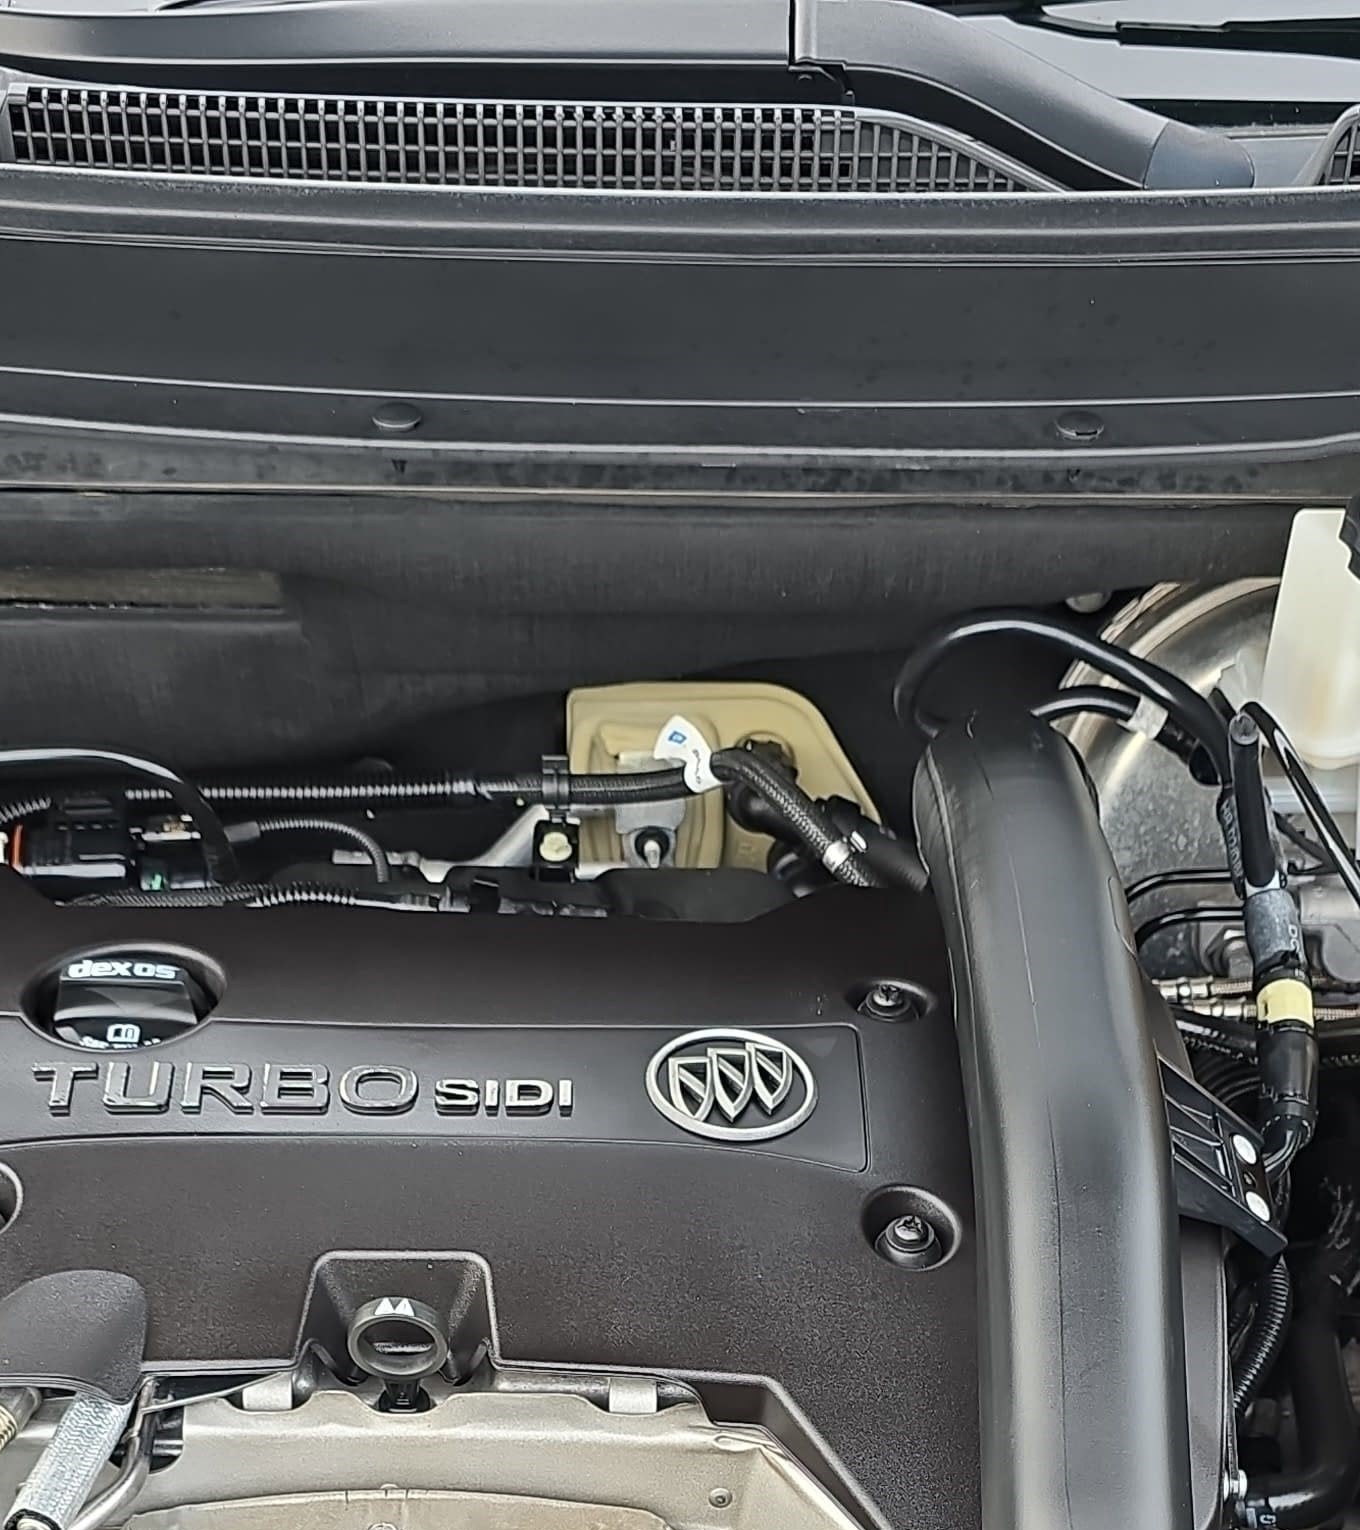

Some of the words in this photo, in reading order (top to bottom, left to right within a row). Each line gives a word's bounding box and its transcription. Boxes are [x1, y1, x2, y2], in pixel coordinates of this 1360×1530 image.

[67, 959, 182, 980] dexos
[31, 1061, 419, 1116] TURBO
[433, 1078, 574, 1117] SIDI
